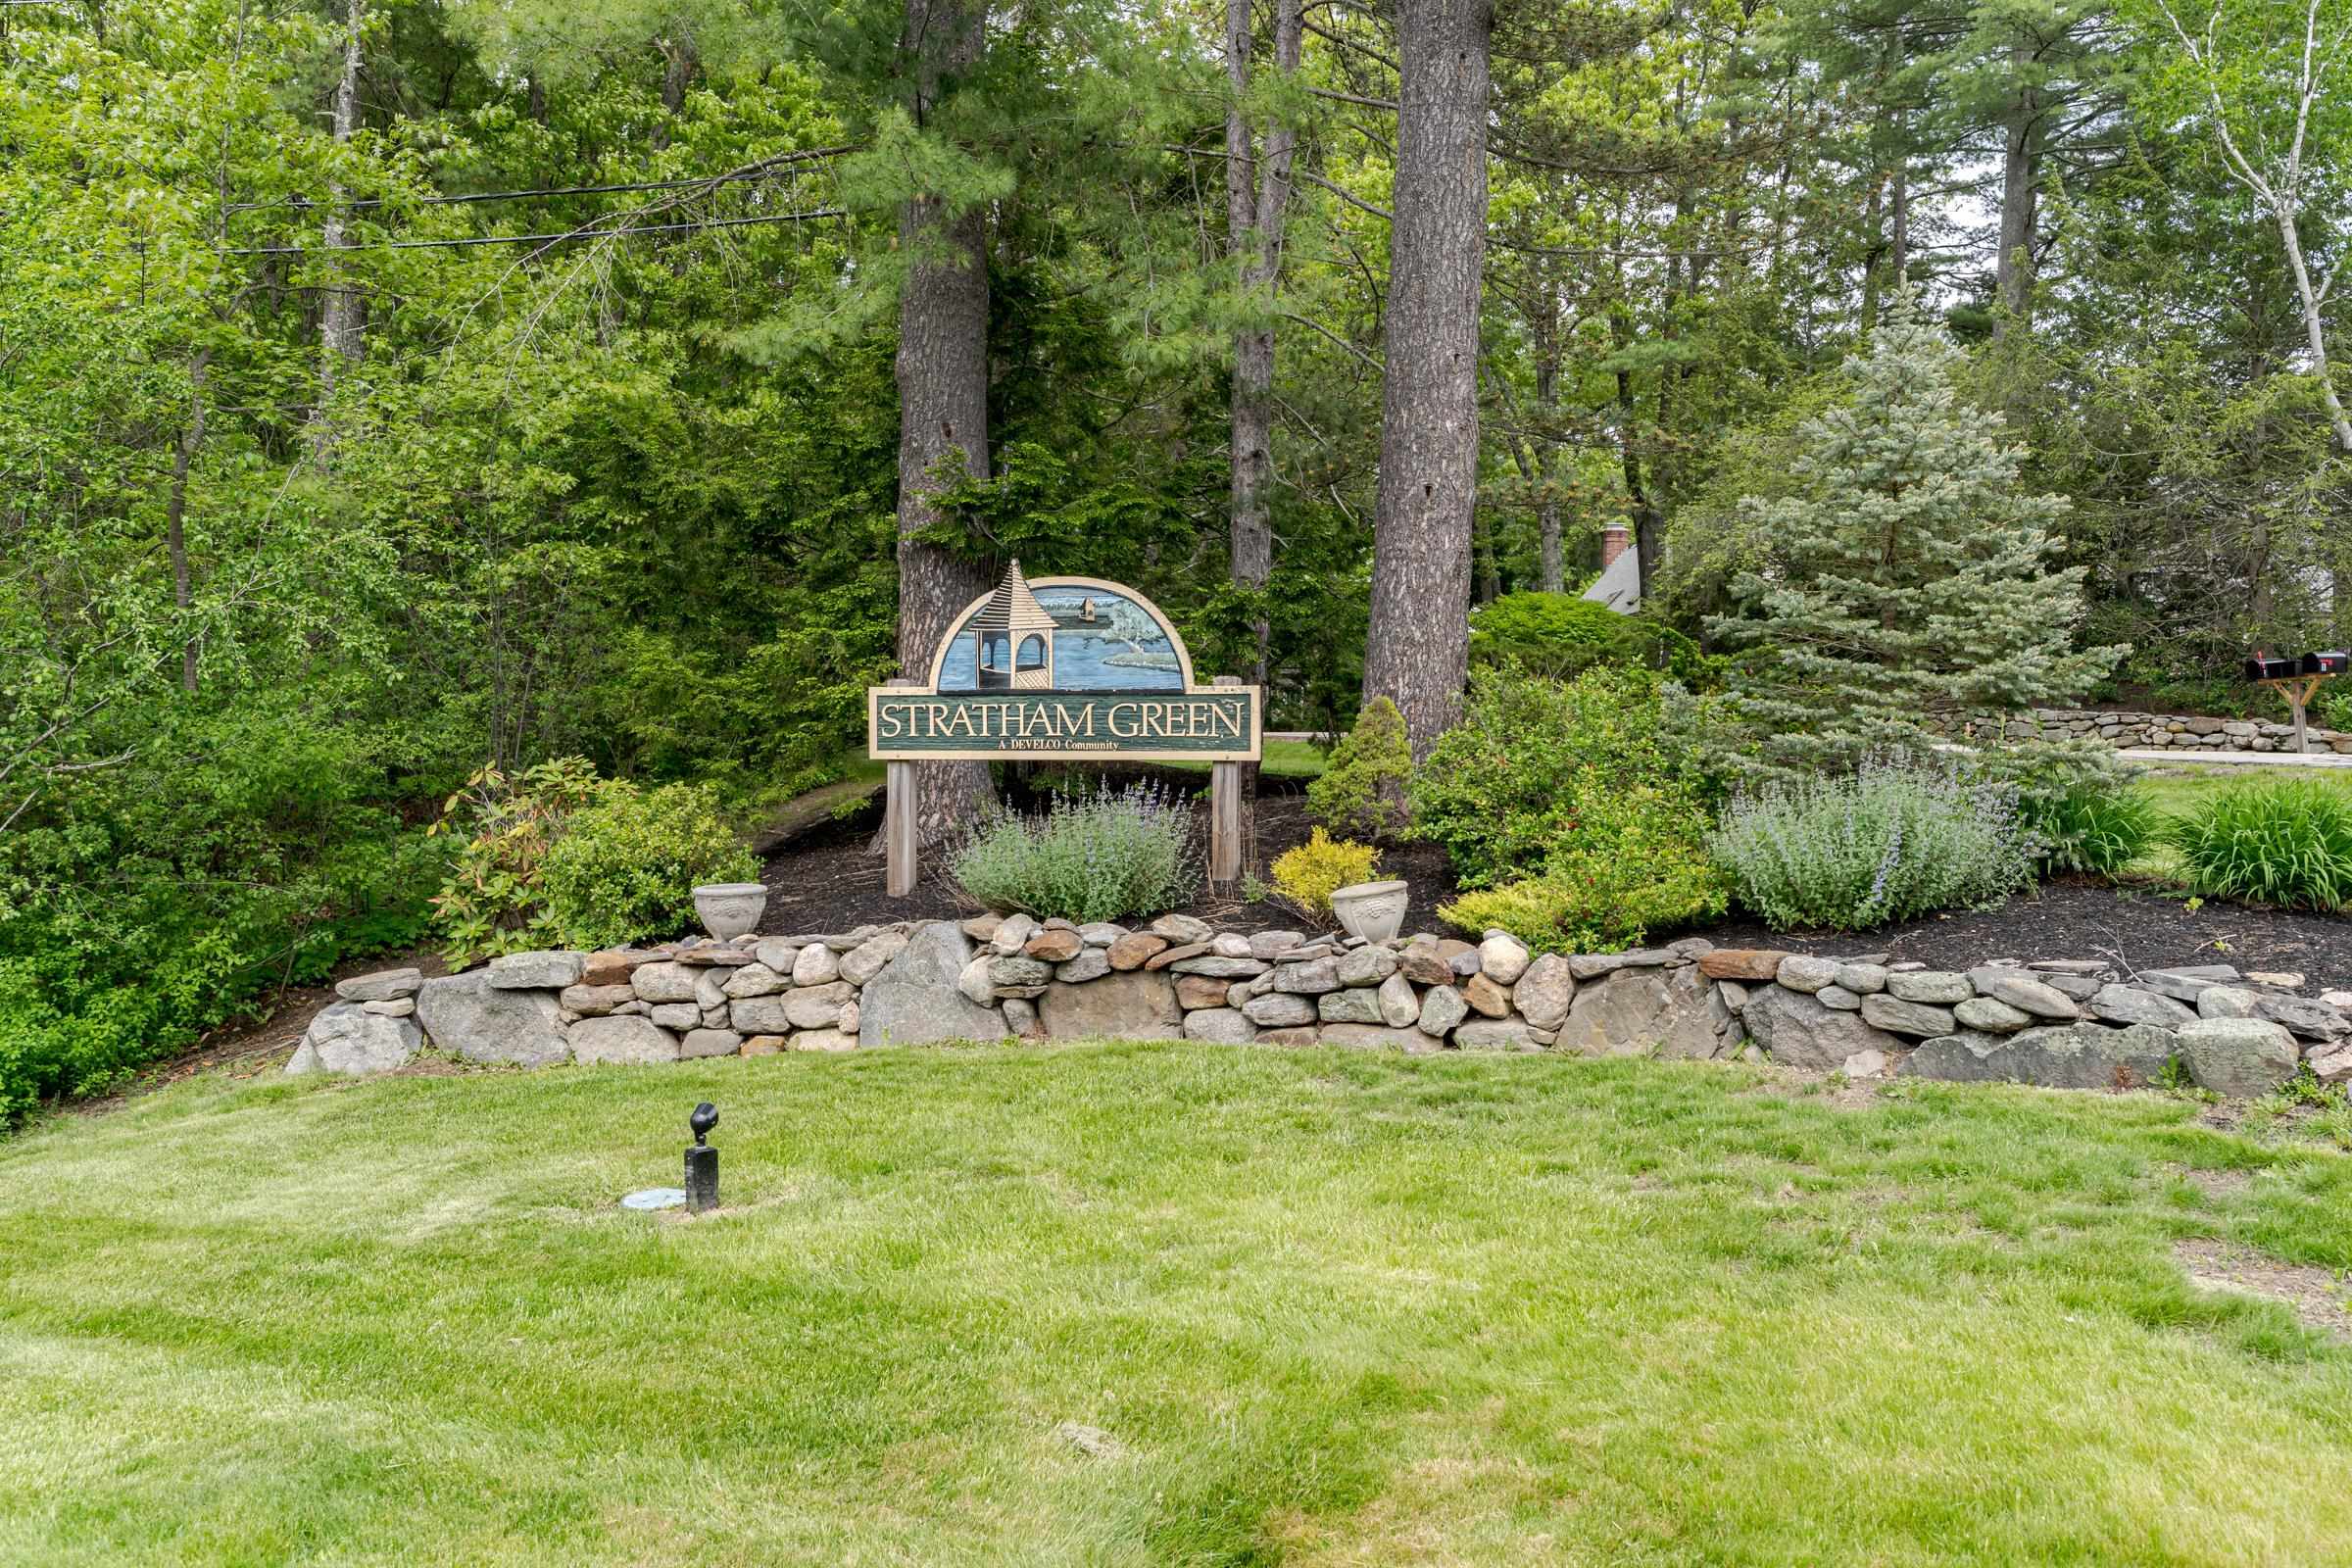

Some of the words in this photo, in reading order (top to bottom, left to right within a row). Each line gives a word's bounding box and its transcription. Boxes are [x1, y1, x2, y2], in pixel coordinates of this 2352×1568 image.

[881, 703, 1095, 737] STRATHAM
[1107, 703, 1245, 737] GREEN
[998, 739, 1006, 750] A
[1010, 739, 1060, 750] DEVELCO
[1065, 739, 1119, 751] Community
